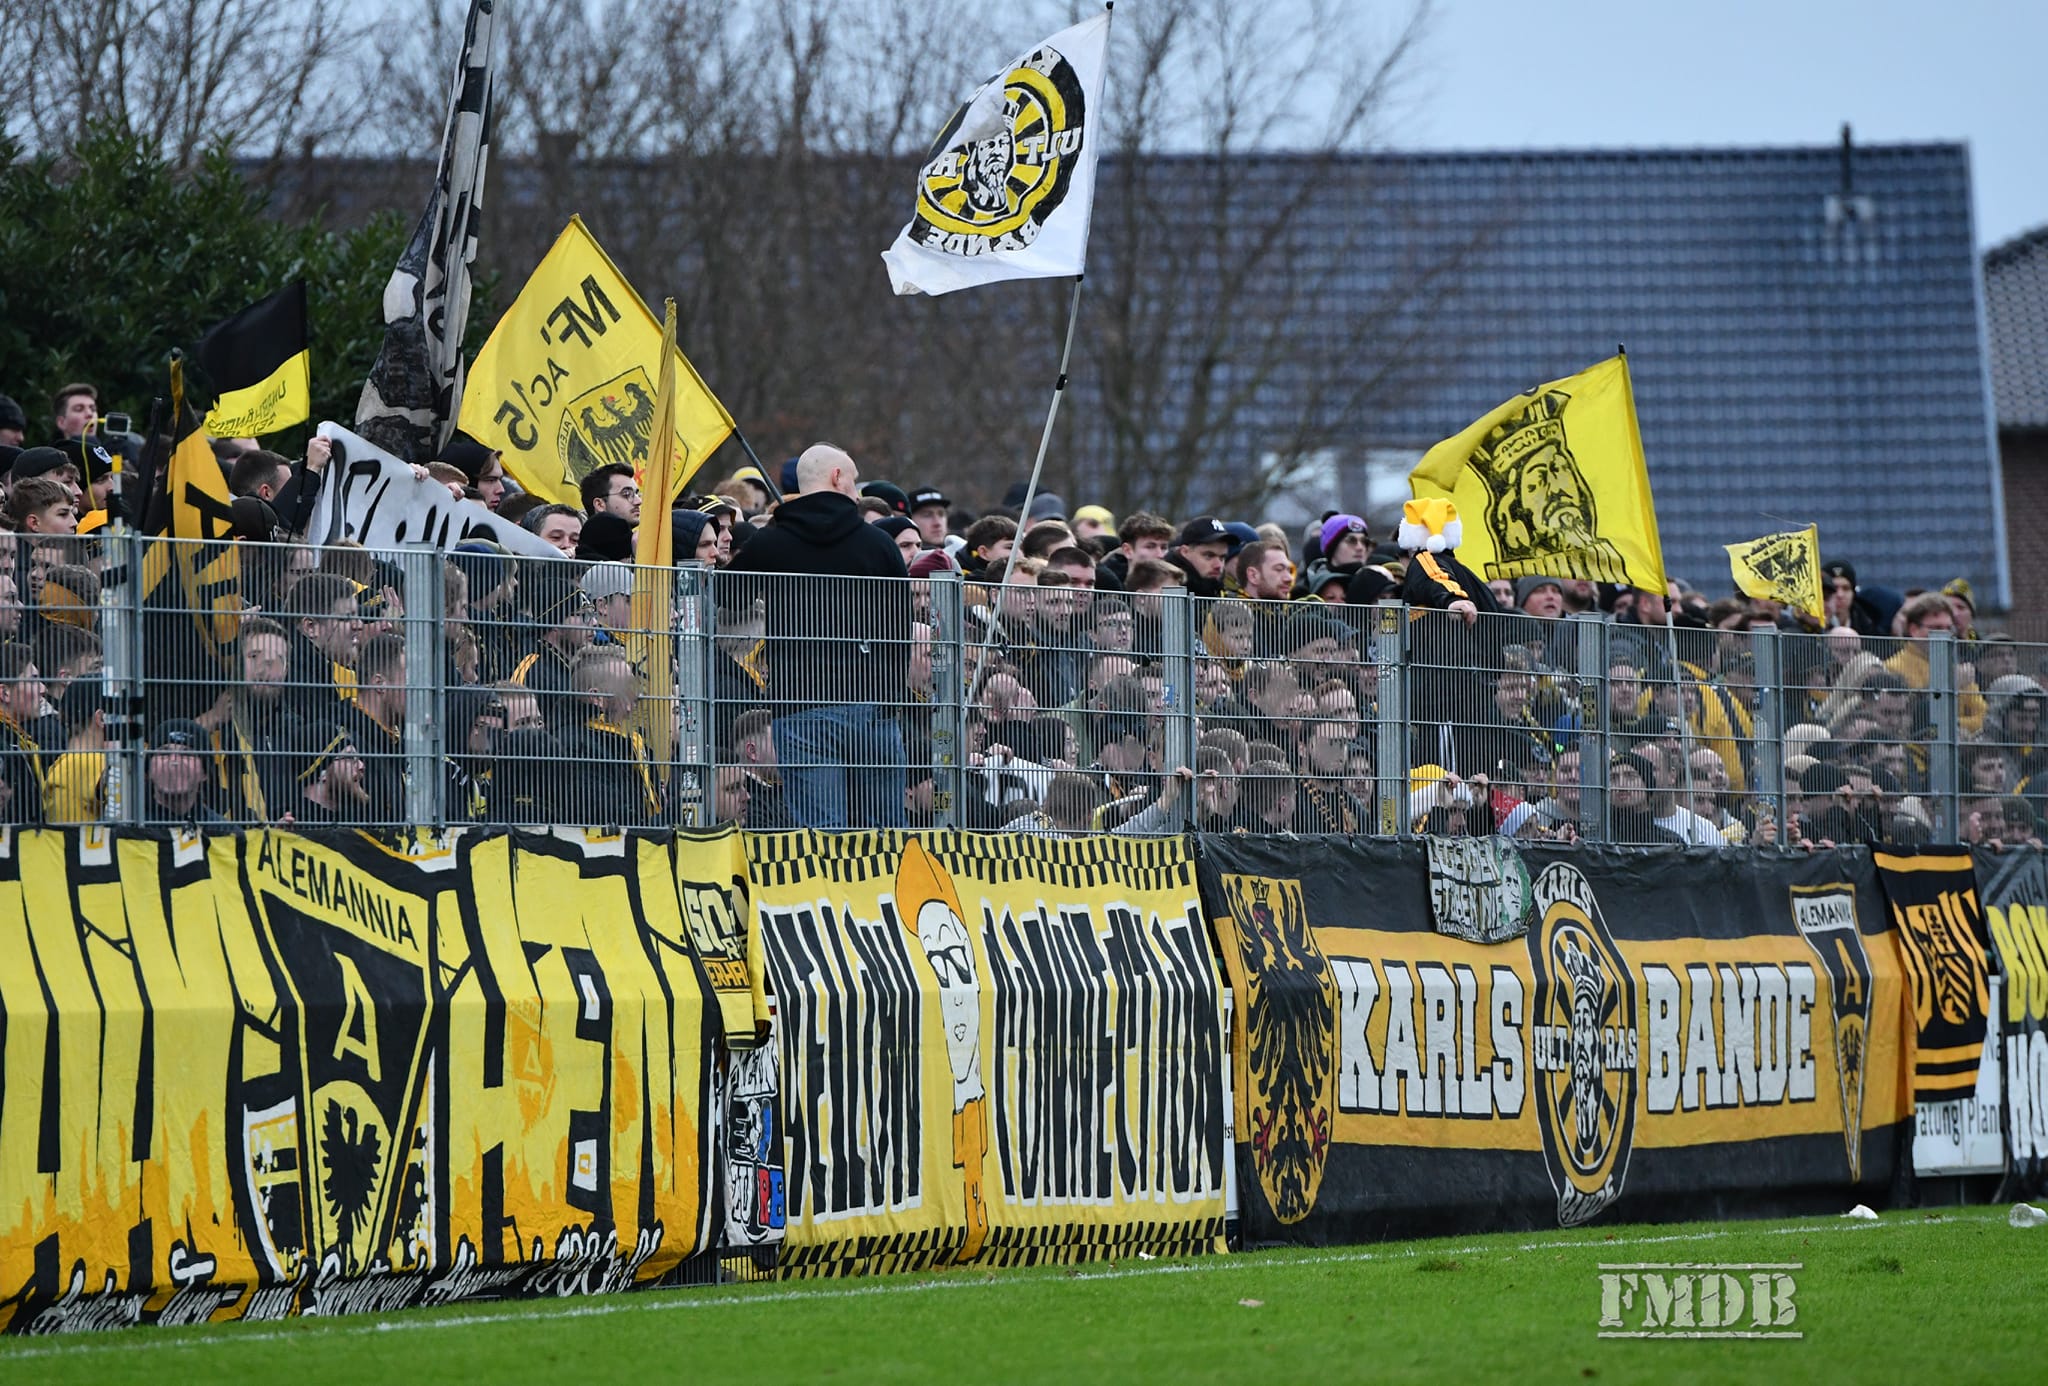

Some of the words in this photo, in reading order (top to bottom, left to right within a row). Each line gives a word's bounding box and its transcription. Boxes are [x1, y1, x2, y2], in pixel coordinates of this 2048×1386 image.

[258, 835, 419, 952] ALEMANNIA
[1534, 864, 1593, 920] KARLS
[758, 895, 922, 1224] YELLOW
[980, 896, 1225, 1207] CONNECTION
[1328, 956, 1526, 1120] KARLS
[1641, 961, 1816, 1114] BANDE
